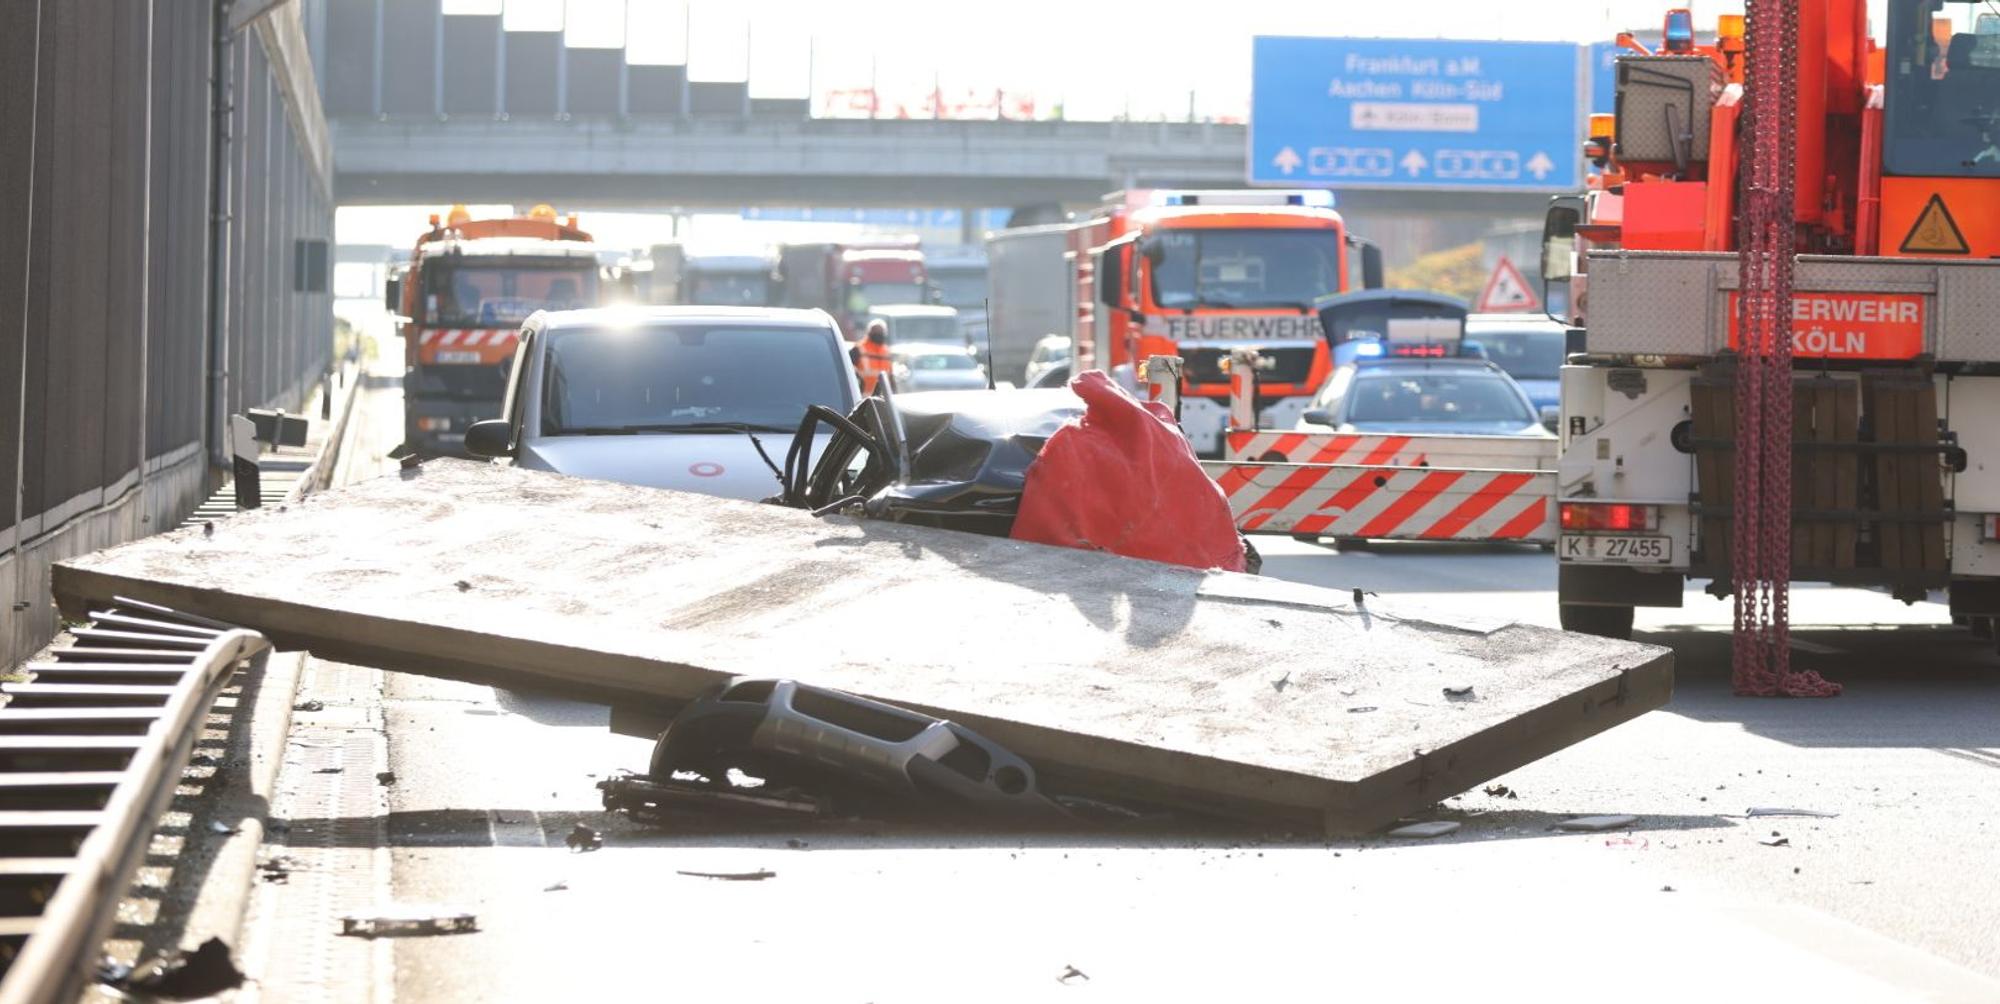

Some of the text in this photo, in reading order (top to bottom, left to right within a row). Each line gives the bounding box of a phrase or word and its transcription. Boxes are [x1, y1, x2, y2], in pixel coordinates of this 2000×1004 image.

[1345, 53, 1439, 76] Frankfurt
[1328, 79, 1402, 99] Aachen
[1735, 298, 1918, 323] ERWEHR
[1168, 317, 1325, 339] FEUERWEHR
[1792, 326, 1865, 353] KÖLN
[1568, 538, 1662, 557] K 27455
